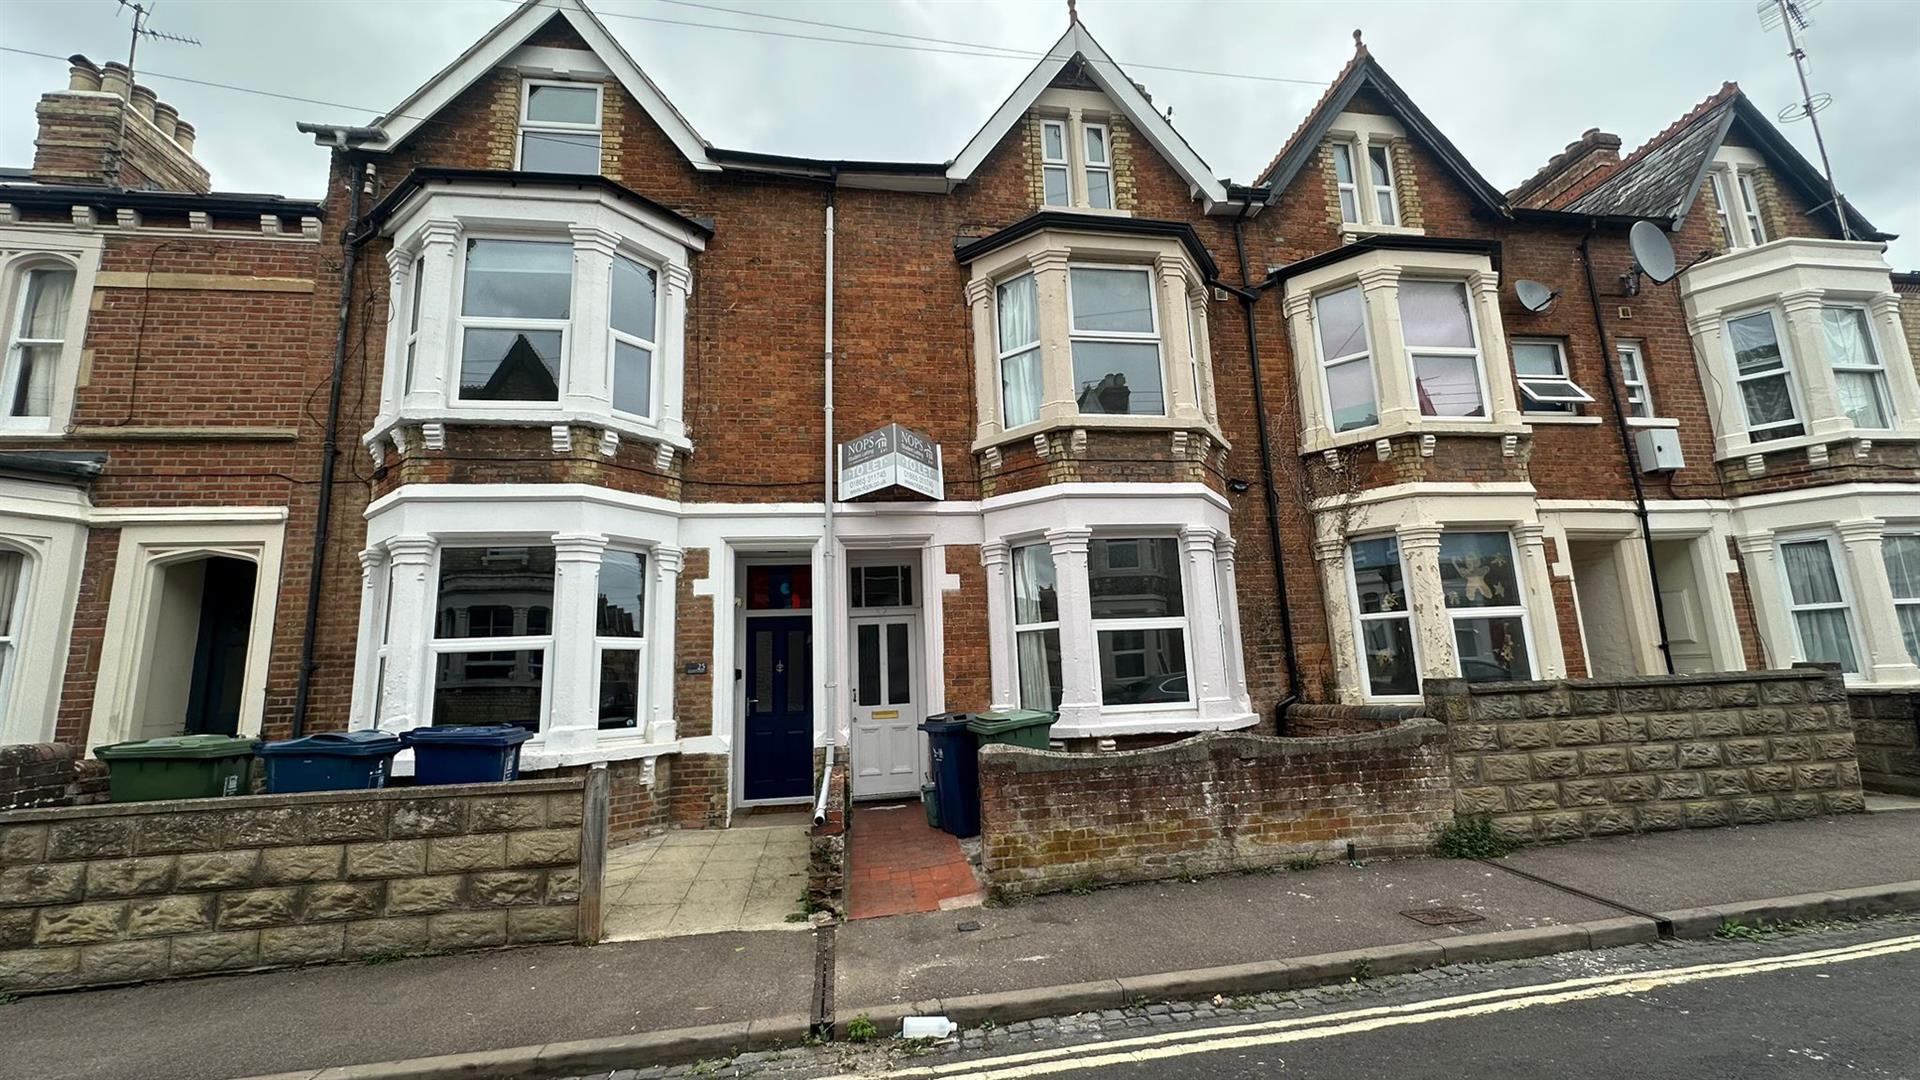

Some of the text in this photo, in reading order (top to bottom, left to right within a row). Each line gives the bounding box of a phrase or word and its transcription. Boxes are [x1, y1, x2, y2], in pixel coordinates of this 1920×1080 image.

[848, 435, 875, 455] NOPS
[901, 431, 923, 451] NOPS
[851, 464, 863, 478] TO
[867, 457, 884, 472] LET
[918, 462, 932, 480] LET
